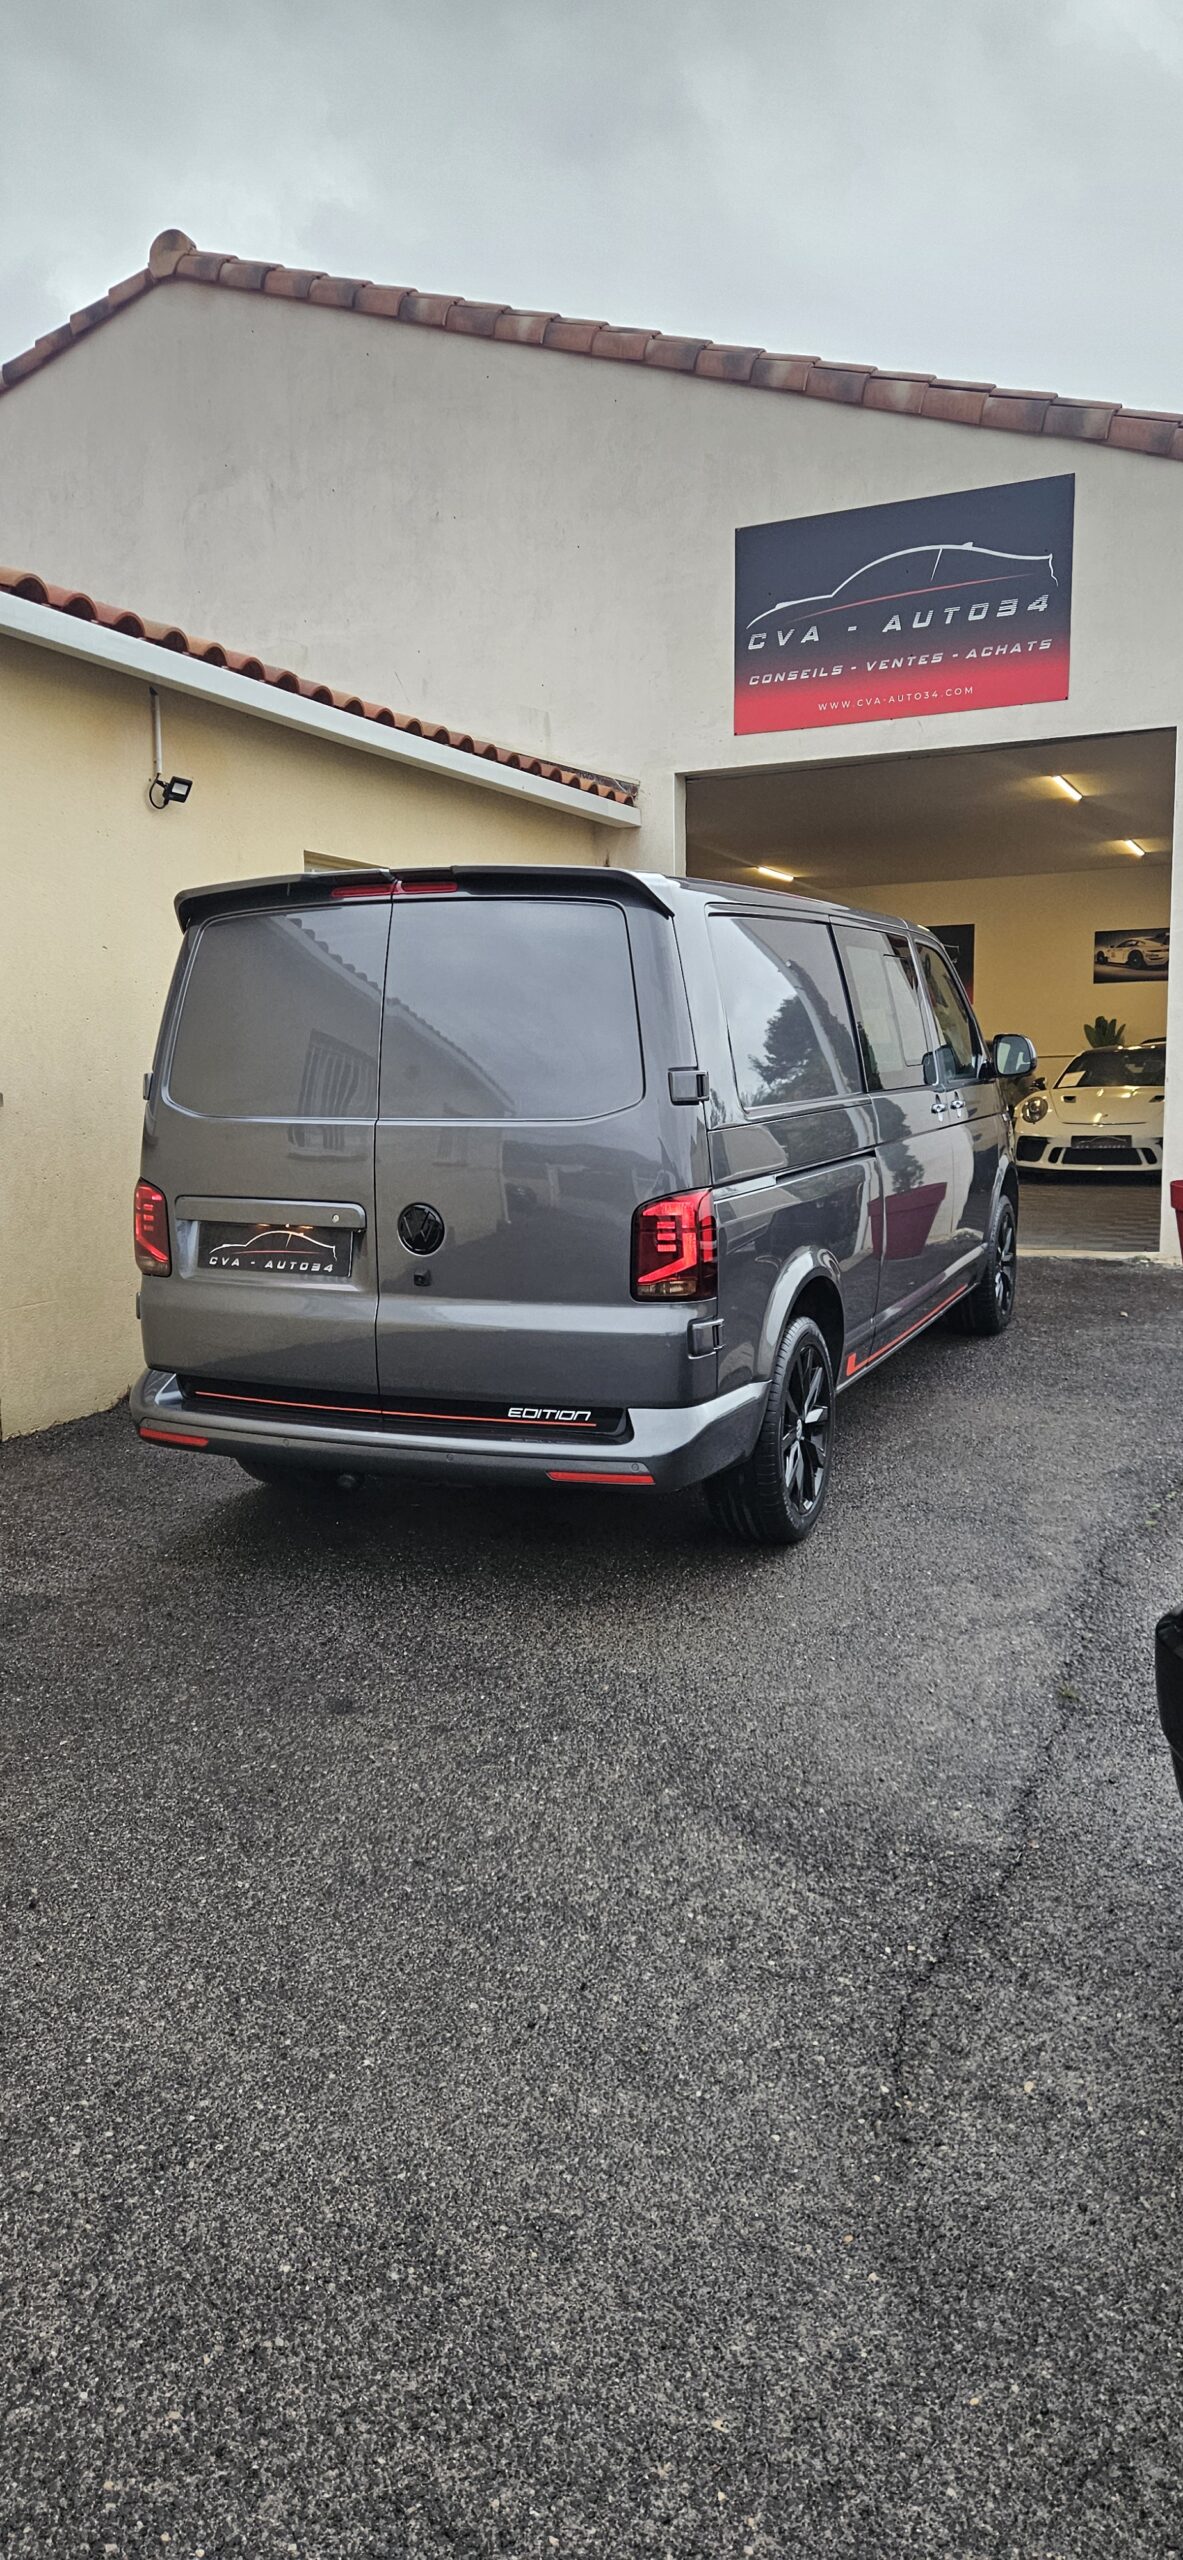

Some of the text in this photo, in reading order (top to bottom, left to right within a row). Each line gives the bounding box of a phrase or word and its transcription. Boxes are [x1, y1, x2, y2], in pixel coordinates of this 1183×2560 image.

[748, 625, 819, 650] CVA
[882, 594, 1049, 632] AUTO34
[749, 665, 843, 685] CONSEILS
[866, 652, 943, 672] VENTES
[965, 639, 1052, 659] ACHATS
[818, 686, 973, 711] WWW.CVA-AUTO34.COM
[209, 1256, 240, 1266] CVA
[264, 1260, 333, 1272] AUTO34
[508, 1407, 592, 1421] EDITION
